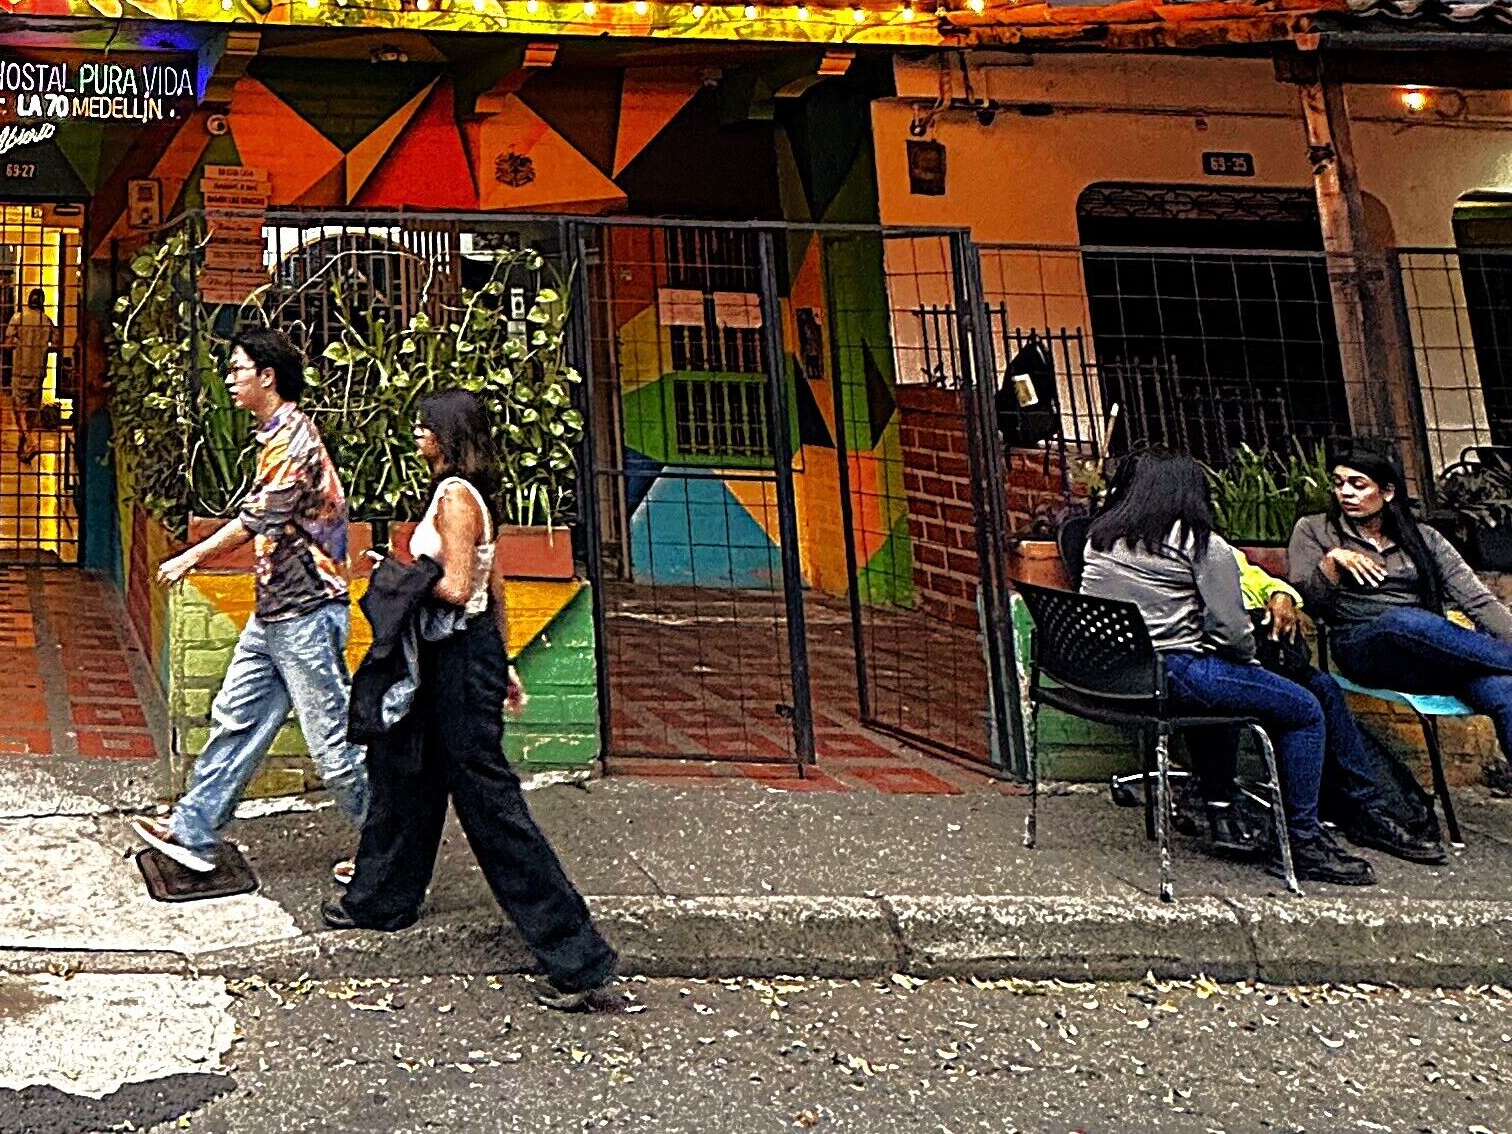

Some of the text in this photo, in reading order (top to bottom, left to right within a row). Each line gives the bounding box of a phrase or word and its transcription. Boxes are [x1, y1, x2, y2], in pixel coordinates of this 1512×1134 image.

[79, 63, 138, 95] PURA
[142, 66, 194, 96] VIDA
[17, 94, 43, 117] LA
[44, 93, 69, 118] 70
